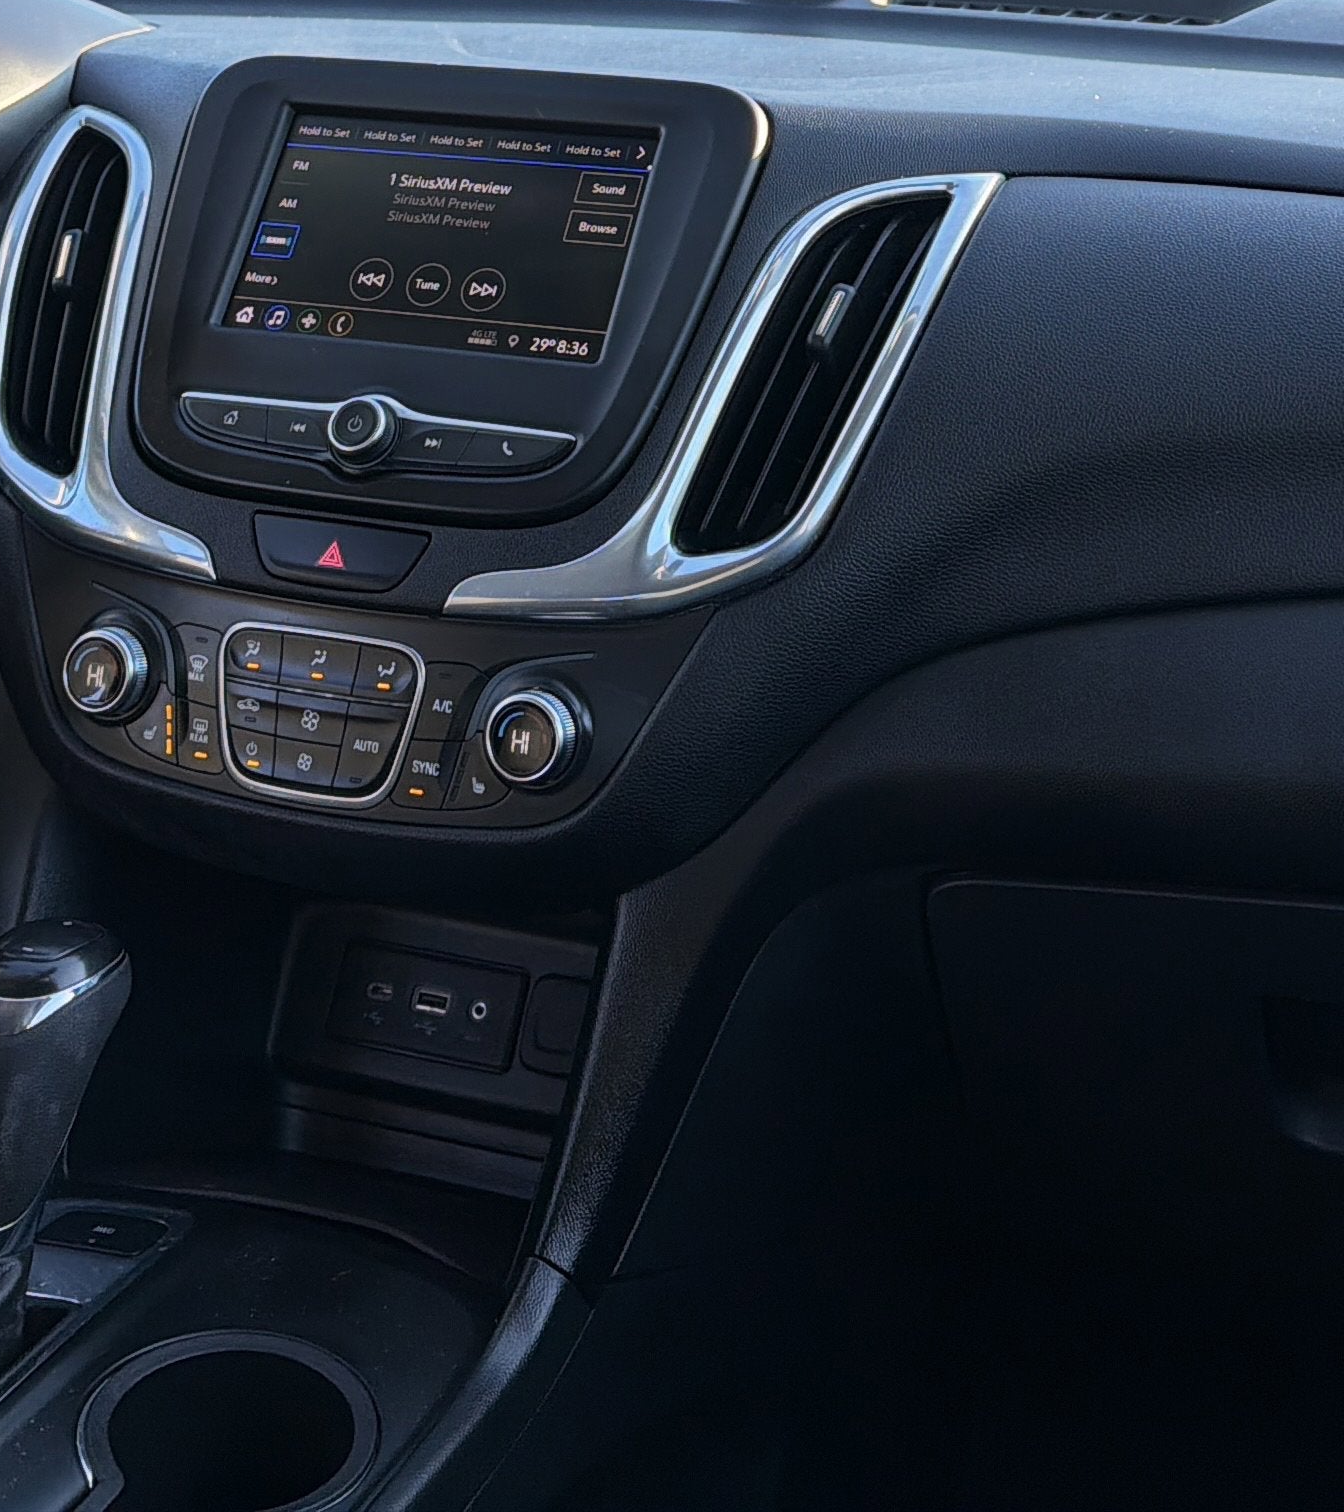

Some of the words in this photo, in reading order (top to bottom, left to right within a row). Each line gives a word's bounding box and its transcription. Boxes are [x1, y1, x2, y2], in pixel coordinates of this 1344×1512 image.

[299, 126, 322, 137] Hold
[322, 128, 332, 137] to
[333, 128, 350, 138] Set
[363, 131, 386, 141] Hold
[387, 133, 397, 142] to
[398, 133, 416, 143] Set
[430, 135, 453, 145] Hold
[454, 137, 464, 146] to
[466, 138, 483, 148] Set
[497, 140, 520, 151] Hold
[522, 142, 532, 152] to
[533, 142, 551, 153] Set
[565, 145, 589, 156] Hold
[591, 147, 601, 157] to
[603, 147, 621, 158] Set
[292, 160, 310, 171] FM
[389, 173, 397, 186] 1
[399, 174, 458, 191] SiriusXM
[459, 178, 512, 195] Preview
[591, 183, 627, 196] Sound
[278, 198, 298, 209] AM
[393, 193, 446, 209] SiriusXM
[448, 198, 496, 212] Preview
[387, 210, 441, 225] SiriusXM
[443, 214, 491, 229] Preview
[578, 221, 618, 235] Browse
[244, 271, 272, 284] More
[415, 278, 440, 291] Tune
[471, 329, 482, 338] 4G
[483, 331, 497, 339] LTE
[556, 340, 589, 356] 8:36
[86, 663, 105, 688] HI
[188, 671, 205, 683] MAX
[432, 698, 453, 714] A/C
[189, 732, 209, 744] REAR
[510, 728, 531, 756] HI
[353, 738, 379, 754] AUTO
[411, 759, 441, 777] SYNC
